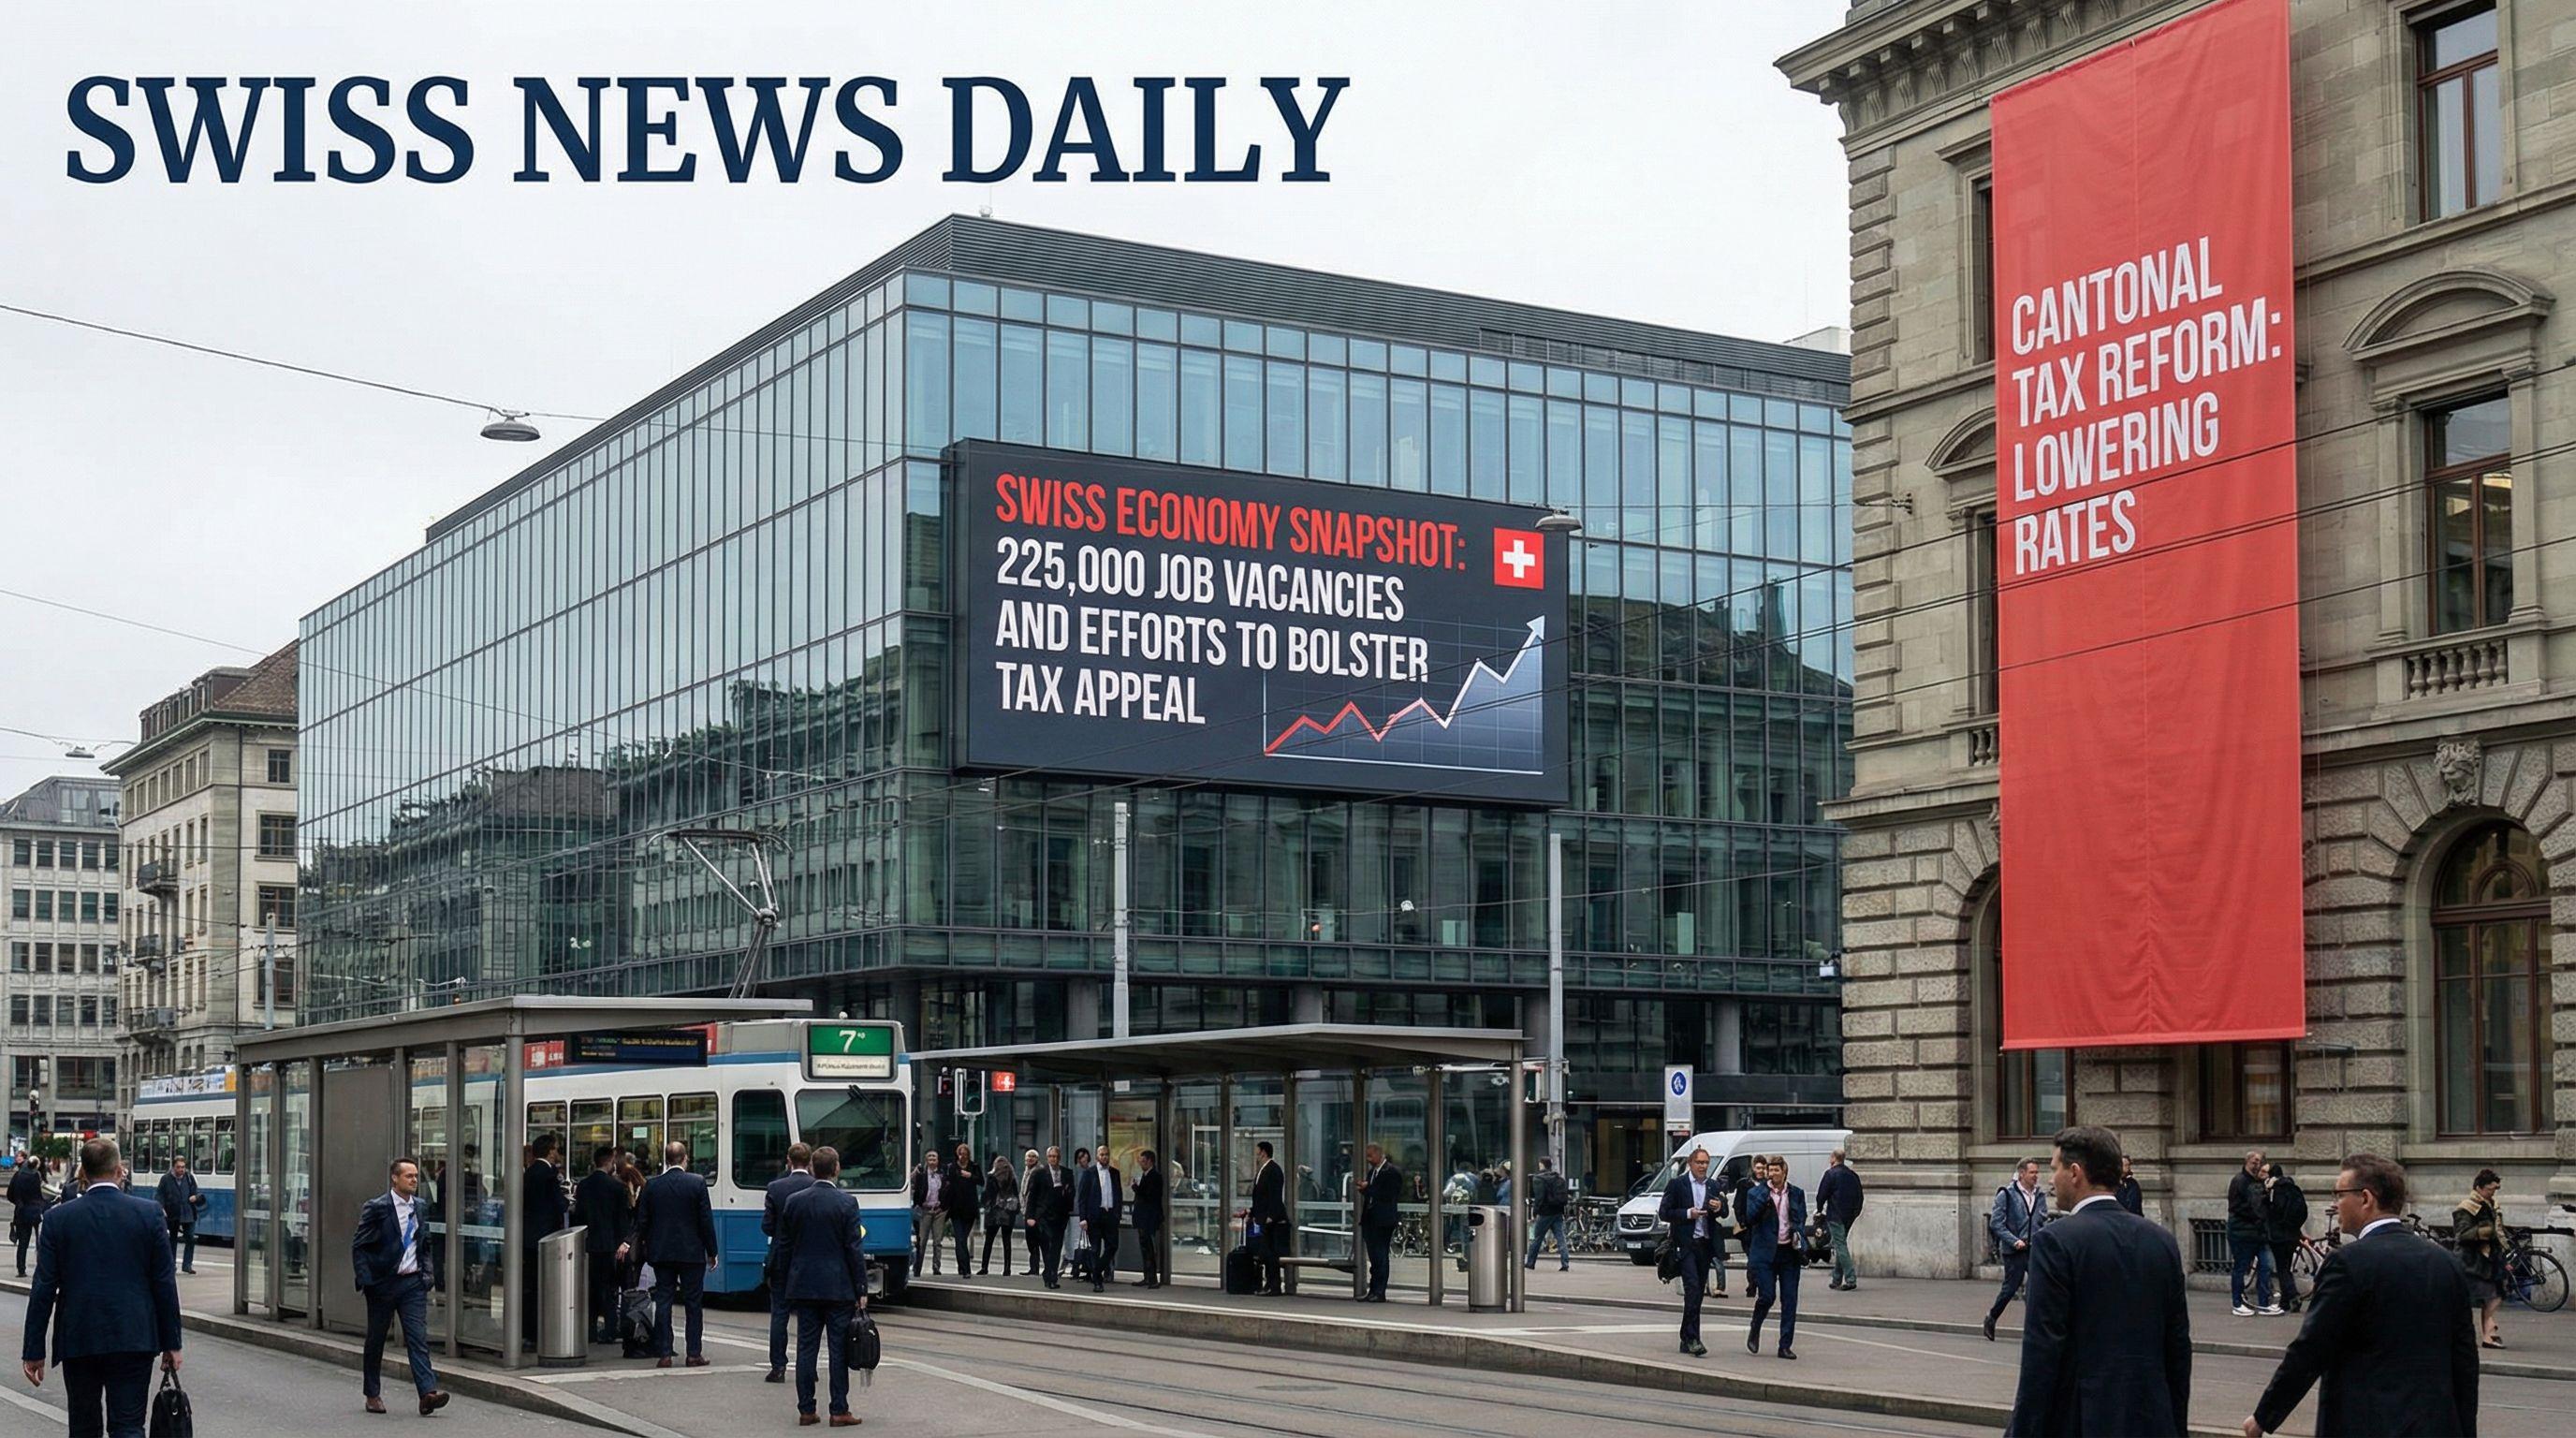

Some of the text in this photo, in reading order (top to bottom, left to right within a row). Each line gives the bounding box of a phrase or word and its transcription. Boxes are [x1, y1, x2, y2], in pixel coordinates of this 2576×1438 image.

[2012, 235, 2223, 356] CANTONAL
[2012, 297, 2282, 428] TAX REFORM:
[2013, 390, 2219, 503] LOWERING
[995, 473, 1467, 571] SWISS ECONOMY SNAPSHOT:
[2014, 489, 2137, 576] RATES
[996, 536, 1405, 623] 225,000 JOB VACANCIES
[995, 599, 1429, 683] AND EFFORTS TO BOLSTER
[995, 661, 1206, 726] TAX APPEAL
